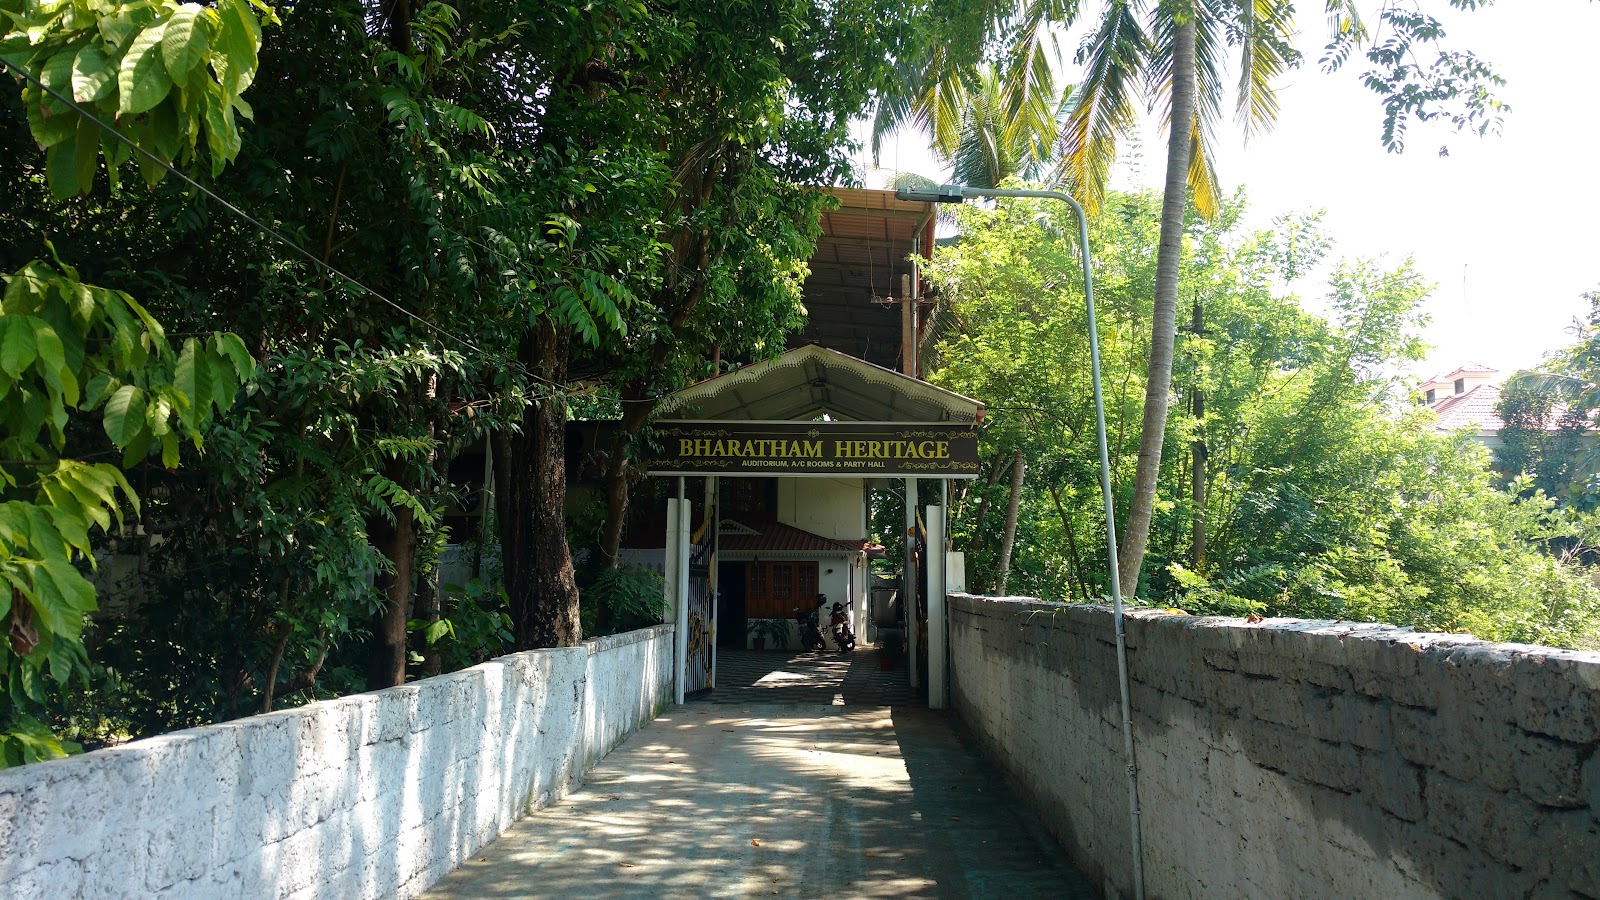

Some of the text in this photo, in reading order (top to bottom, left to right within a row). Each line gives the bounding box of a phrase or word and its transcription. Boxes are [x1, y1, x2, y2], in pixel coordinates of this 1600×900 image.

[678, 438, 950, 459] BHARATHAM HERITAGE
[741, 460, 789, 468] AUDITORIUM,
[791, 460, 805, 468] A/C
[806, 460, 835, 468] ROOMS
